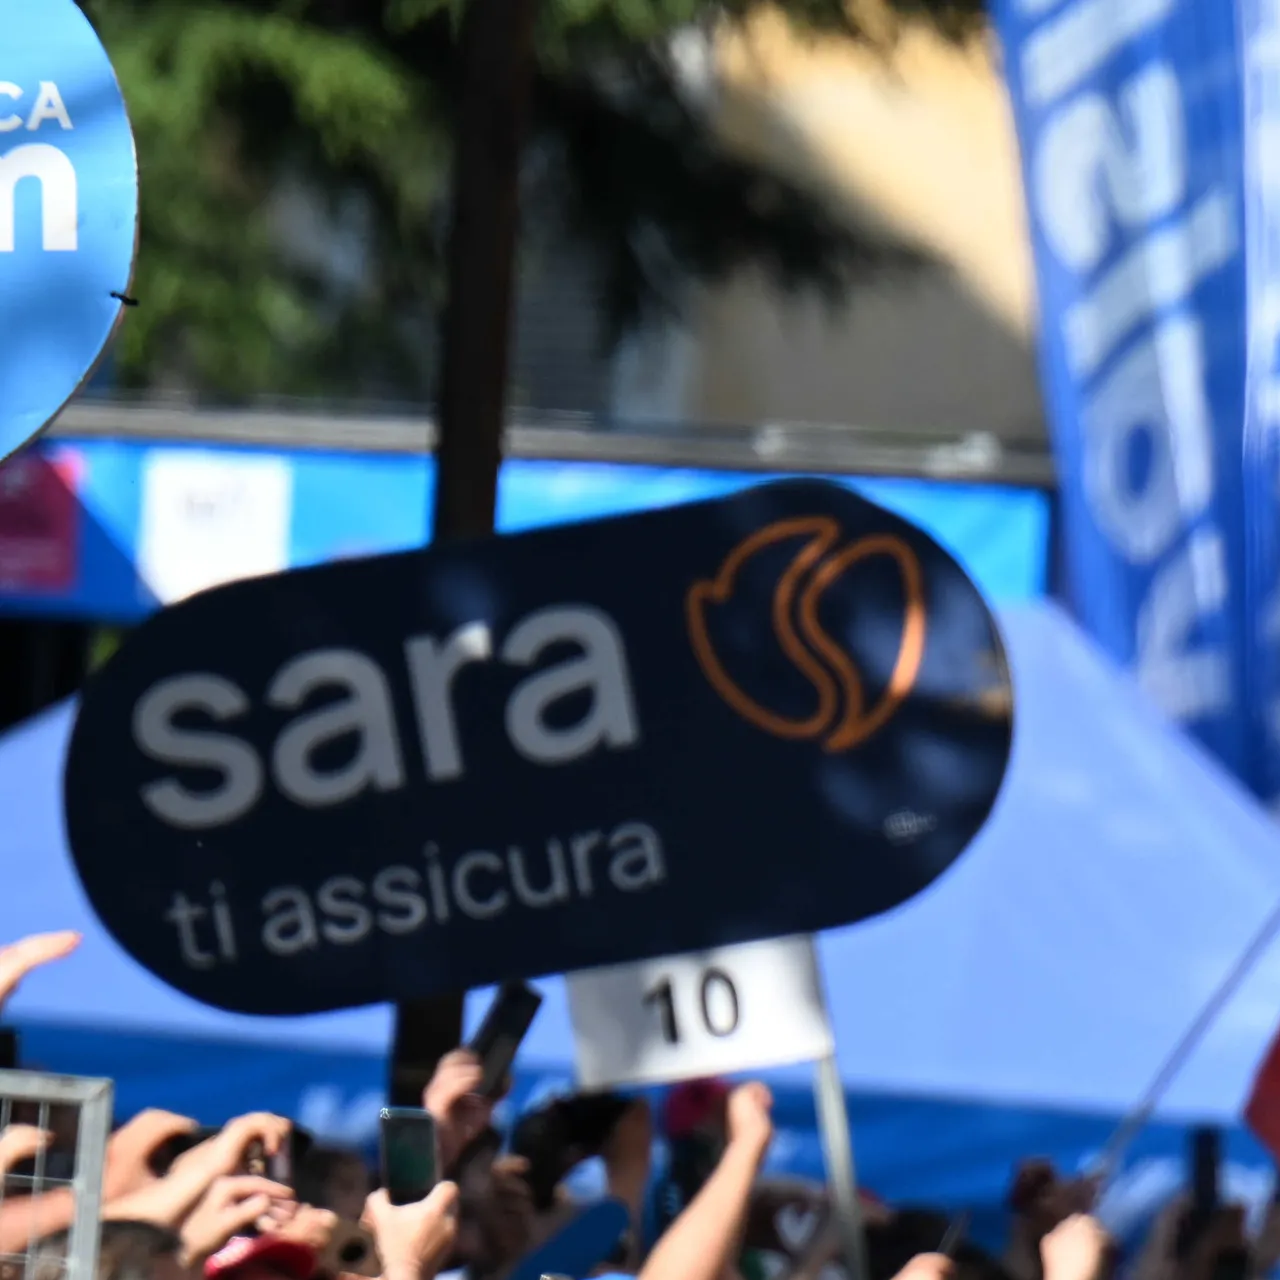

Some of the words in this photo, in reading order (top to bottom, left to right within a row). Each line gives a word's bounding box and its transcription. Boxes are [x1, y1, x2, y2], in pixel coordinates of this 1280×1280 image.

[132, 604, 640, 829] sara
[166, 881, 238, 968] ti
[261, 820, 666, 956] assicura
[643, 966, 739, 1044] 10
